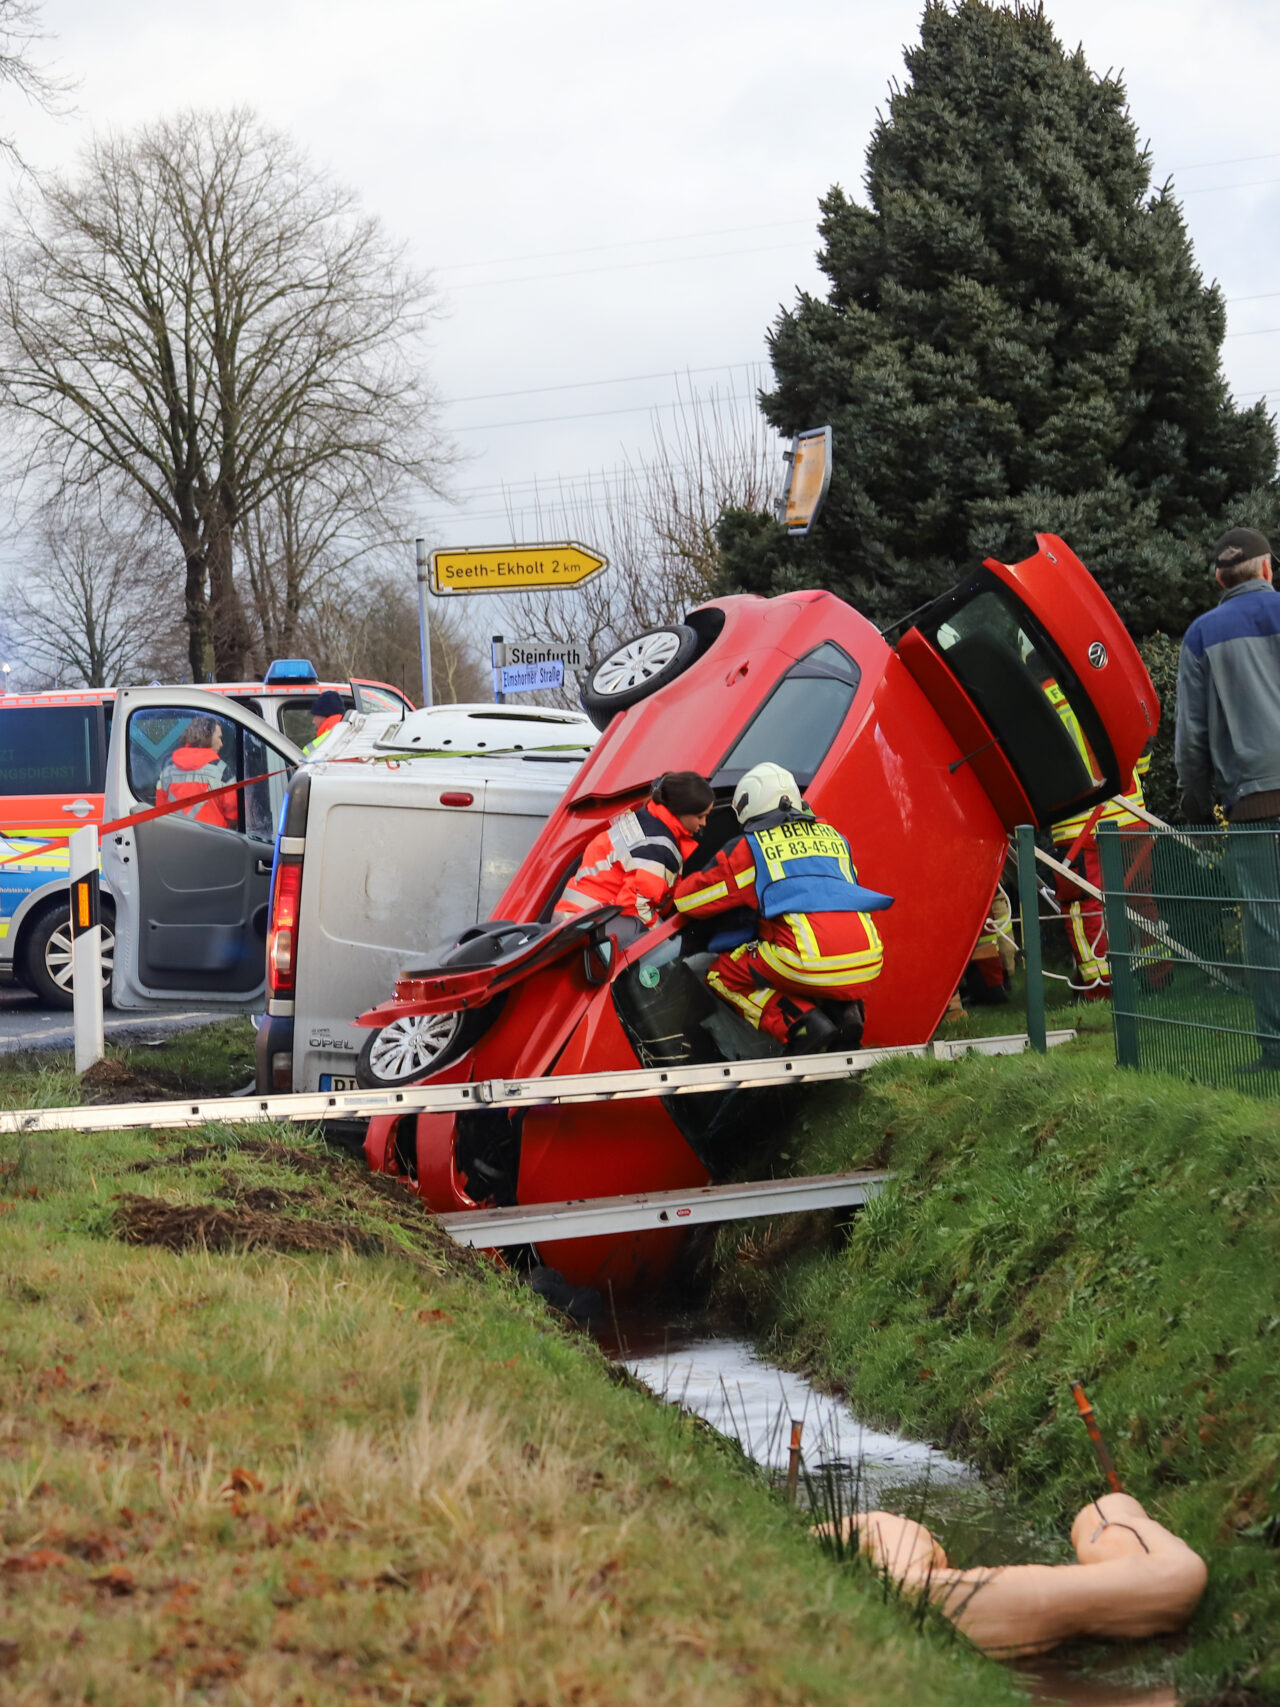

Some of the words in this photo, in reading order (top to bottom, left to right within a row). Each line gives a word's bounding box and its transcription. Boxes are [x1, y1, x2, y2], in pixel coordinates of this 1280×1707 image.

[445, 561, 545, 579] Seeth-Ekholt
[551, 560, 560, 573] 2
[563, 564, 581, 573] km
[511, 648, 580, 665] Steinfurth
[503, 671, 537, 688] Elmshorner
[539, 665, 561, 683] Straße
[757, 829, 776, 844] FF
[780, 823, 838, 839] BEVERN
[764, 844, 784, 861] GF
[788, 841, 846, 856] 83-45-01
[309, 1039, 354, 1049] OPEL
